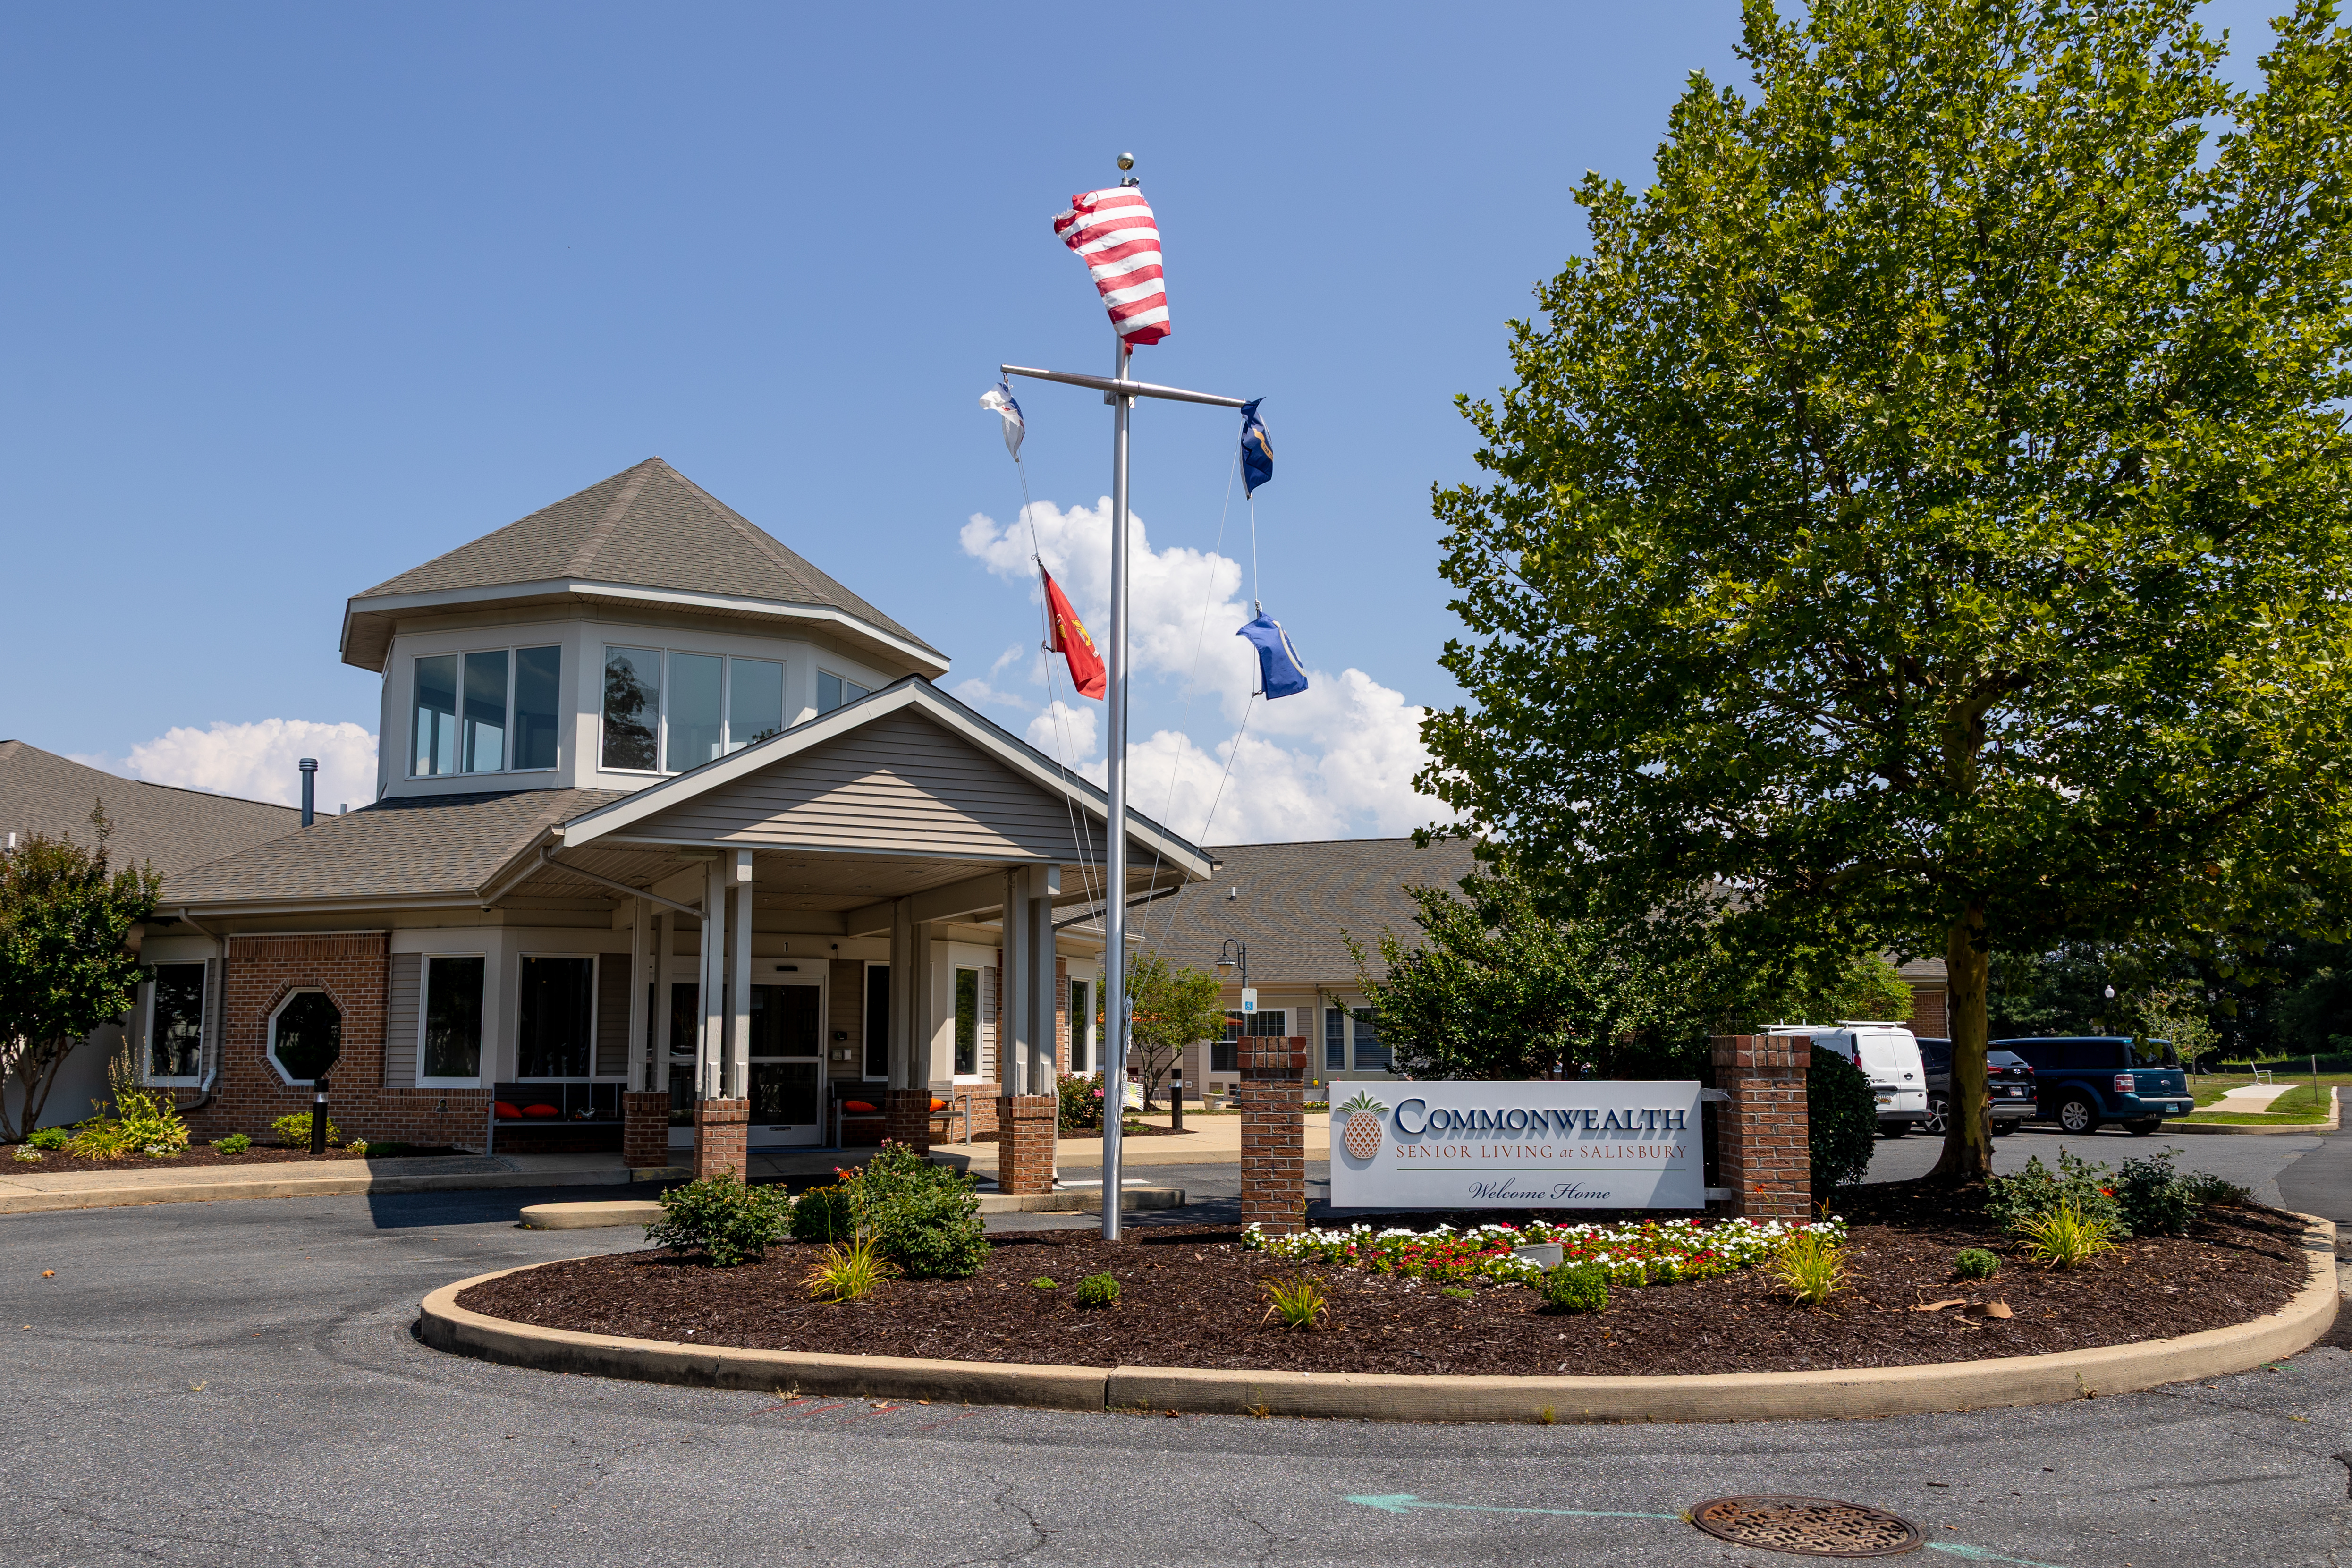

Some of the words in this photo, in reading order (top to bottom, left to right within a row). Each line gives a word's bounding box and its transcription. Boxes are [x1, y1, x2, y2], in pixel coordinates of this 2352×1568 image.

[784, 941, 788, 952] 1
[1395, 1098, 1687, 1134] COMMONWEALTH
[1396, 1145, 1472, 1158] SENIOR
[1481, 1145, 1553, 1158] LIVING
[1560, 1148, 1574, 1158] at
[1580, 1145, 1687, 1158] SALISBURY
[1469, 1177, 1547, 1199] Welcome
[1550, 1182, 1612, 1199] Home
